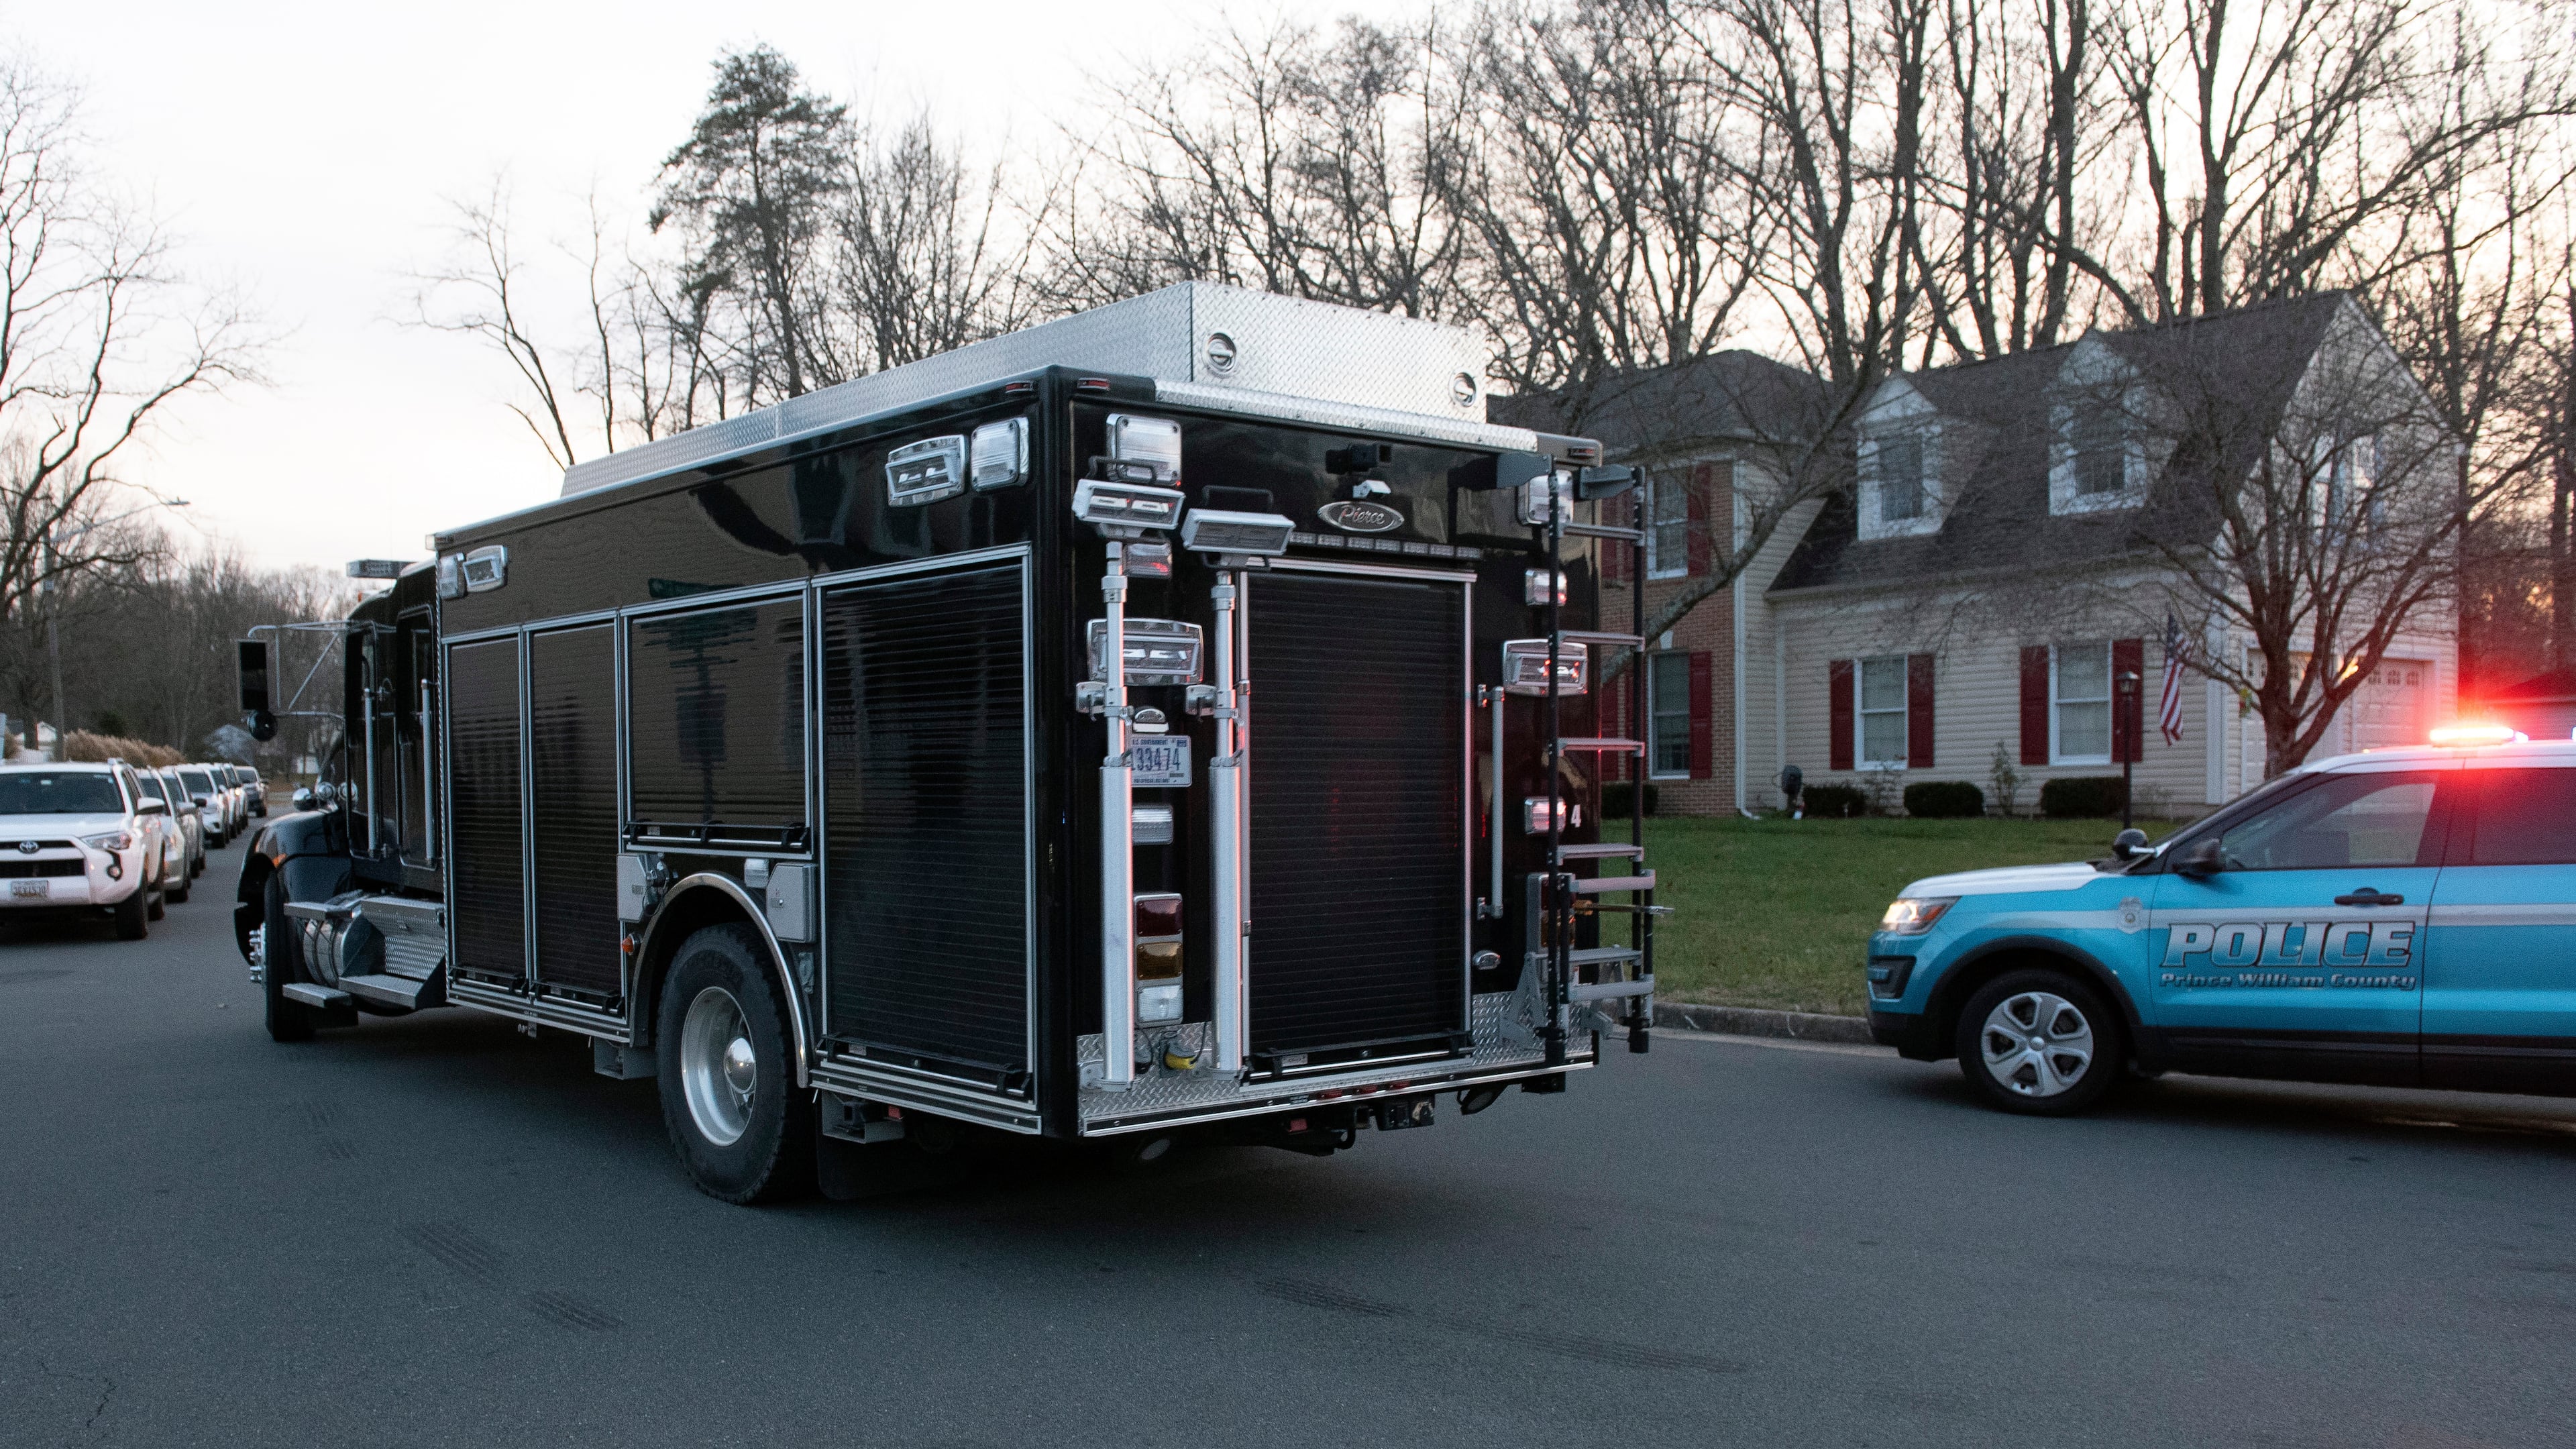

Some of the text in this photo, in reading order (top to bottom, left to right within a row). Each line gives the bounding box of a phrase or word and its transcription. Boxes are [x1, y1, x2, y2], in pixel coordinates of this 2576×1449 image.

[1338, 504, 1385, 525] Pierce
[1570, 804, 1582, 828] 4
[2159, 921, 2415, 967] POLICE
[2159, 973, 2416, 991] Prince William County
